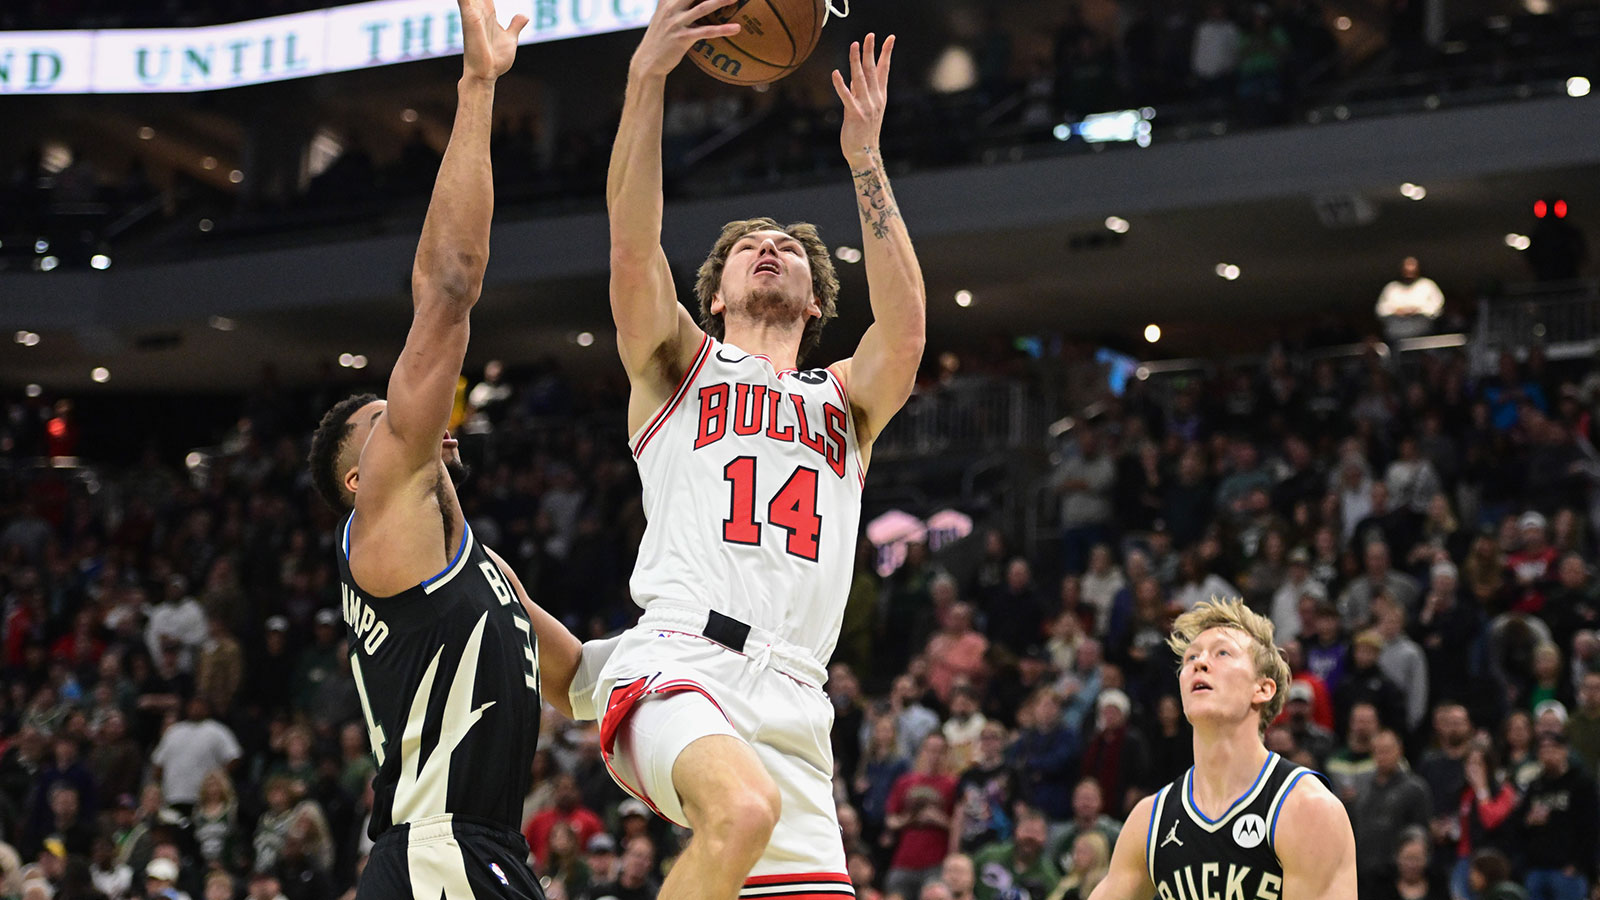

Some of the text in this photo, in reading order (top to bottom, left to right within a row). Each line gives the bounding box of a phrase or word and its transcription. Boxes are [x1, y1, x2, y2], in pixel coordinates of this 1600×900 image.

[133, 32, 309, 85] UNTIL
[534, 0, 645, 30] BUC
[693, 382, 848, 480] BULLS
[723, 456, 823, 563] 14
